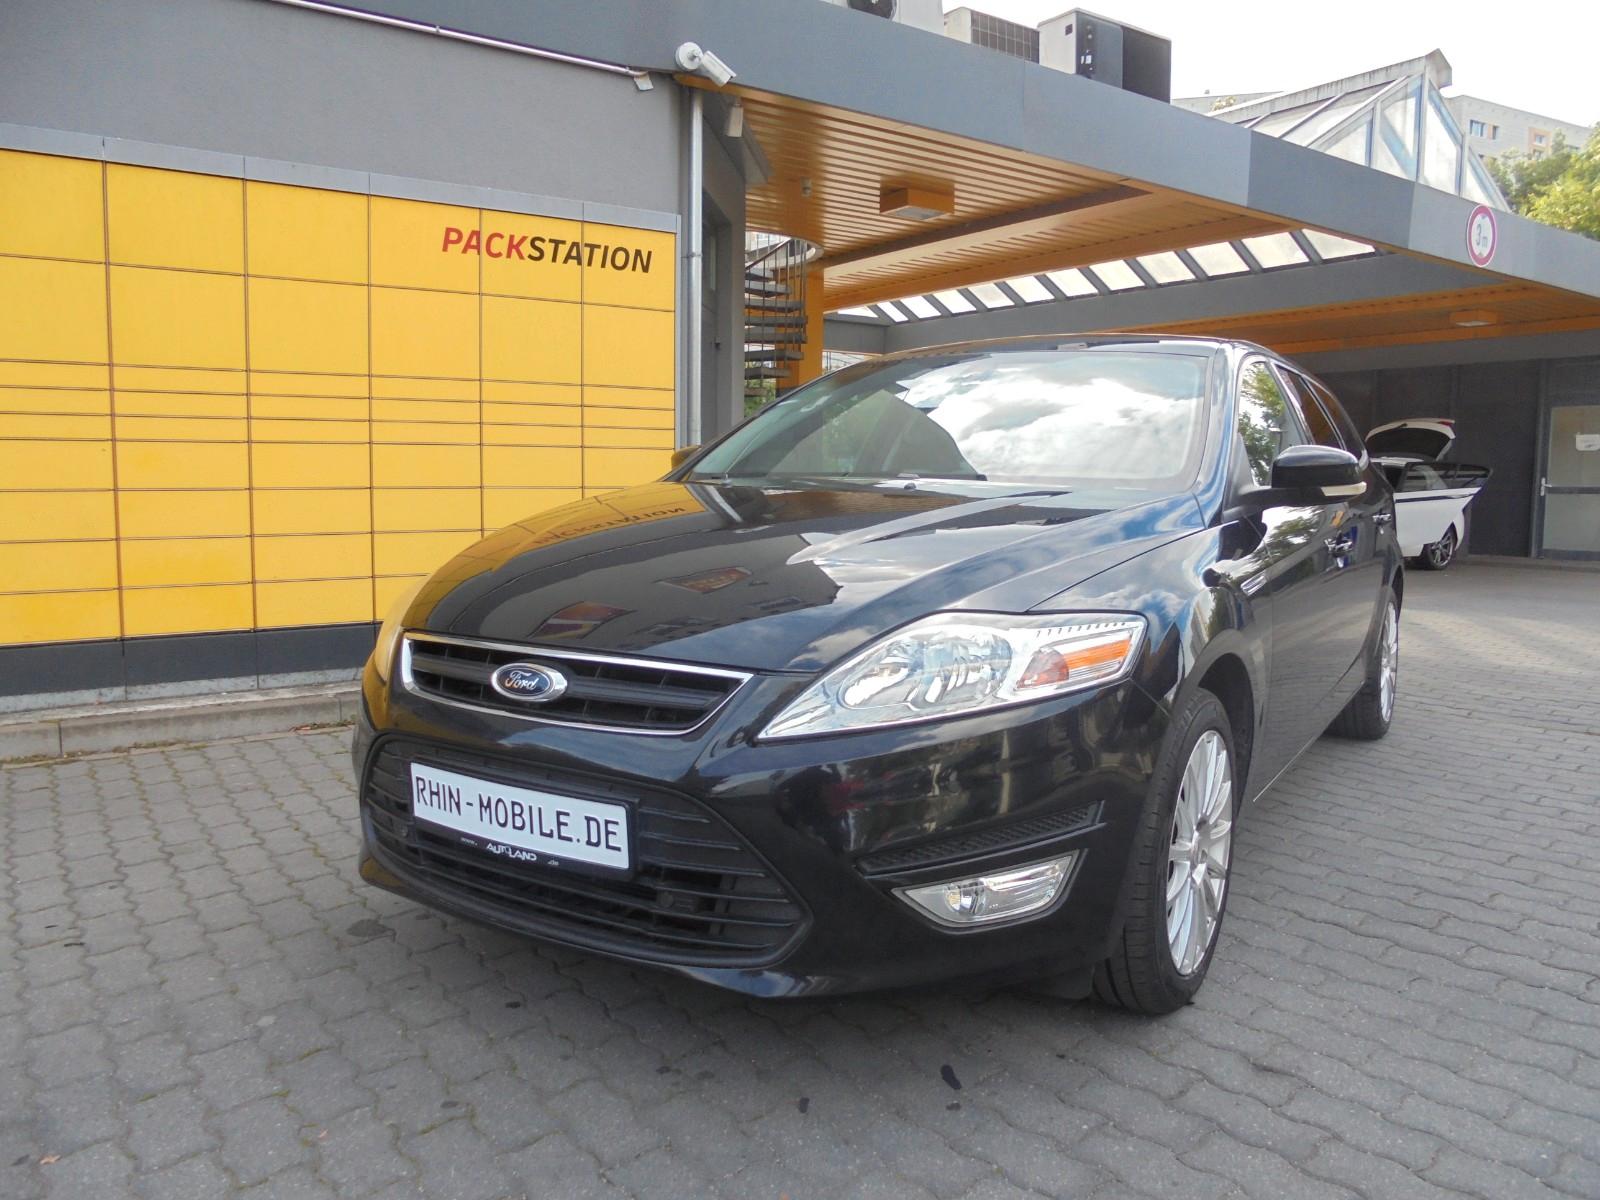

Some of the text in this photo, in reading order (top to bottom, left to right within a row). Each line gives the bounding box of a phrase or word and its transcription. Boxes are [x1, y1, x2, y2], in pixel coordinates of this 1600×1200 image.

[441, 226, 653, 274] PACKSTATION
[504, 670, 540, 691] Ford
[415, 775, 623, 853] RHIN-MOBILE.DE
[486, 842, 538, 861] AUTOLAND
